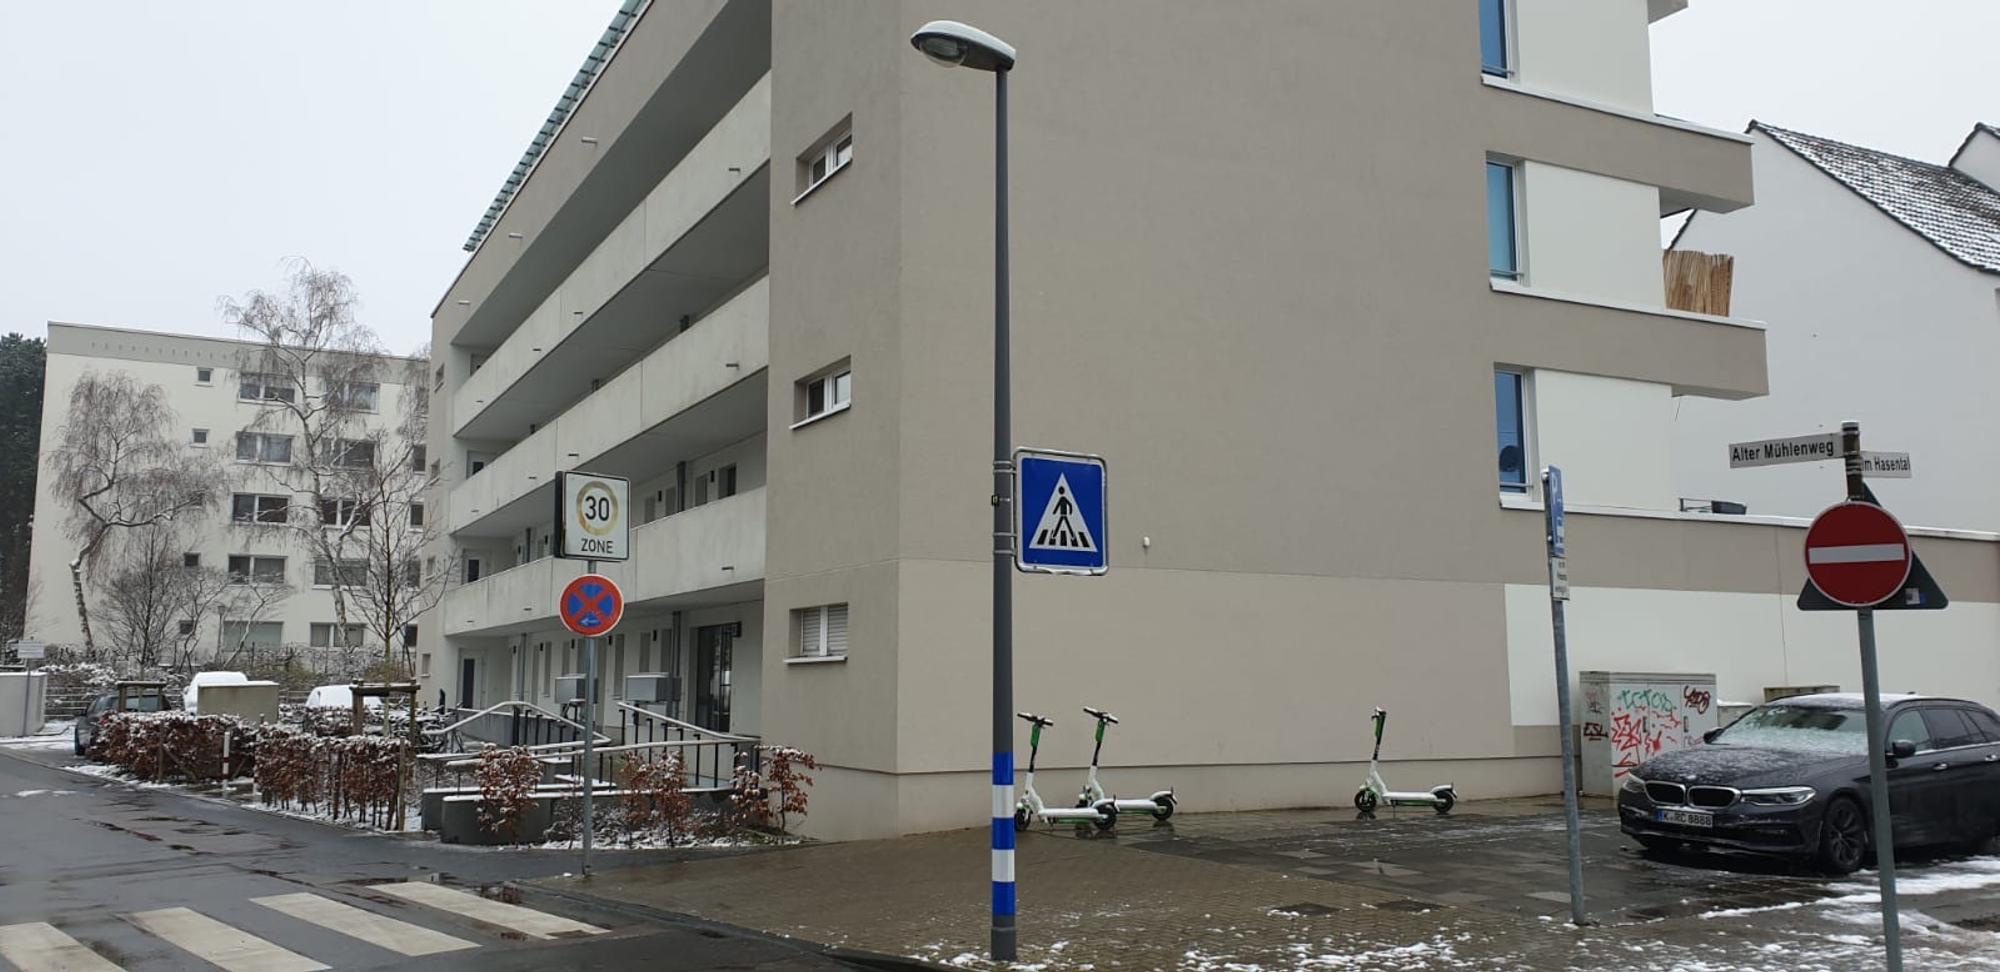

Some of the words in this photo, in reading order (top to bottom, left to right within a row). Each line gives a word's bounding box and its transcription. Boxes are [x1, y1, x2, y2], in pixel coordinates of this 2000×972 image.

[1732, 447, 1761, 462] Alter
[1764, 440, 1834, 459] Mühlenweg
[1874, 455, 1911, 472] Hasental
[585, 495, 610, 521] 30
[581, 538, 613, 554] ZONE
